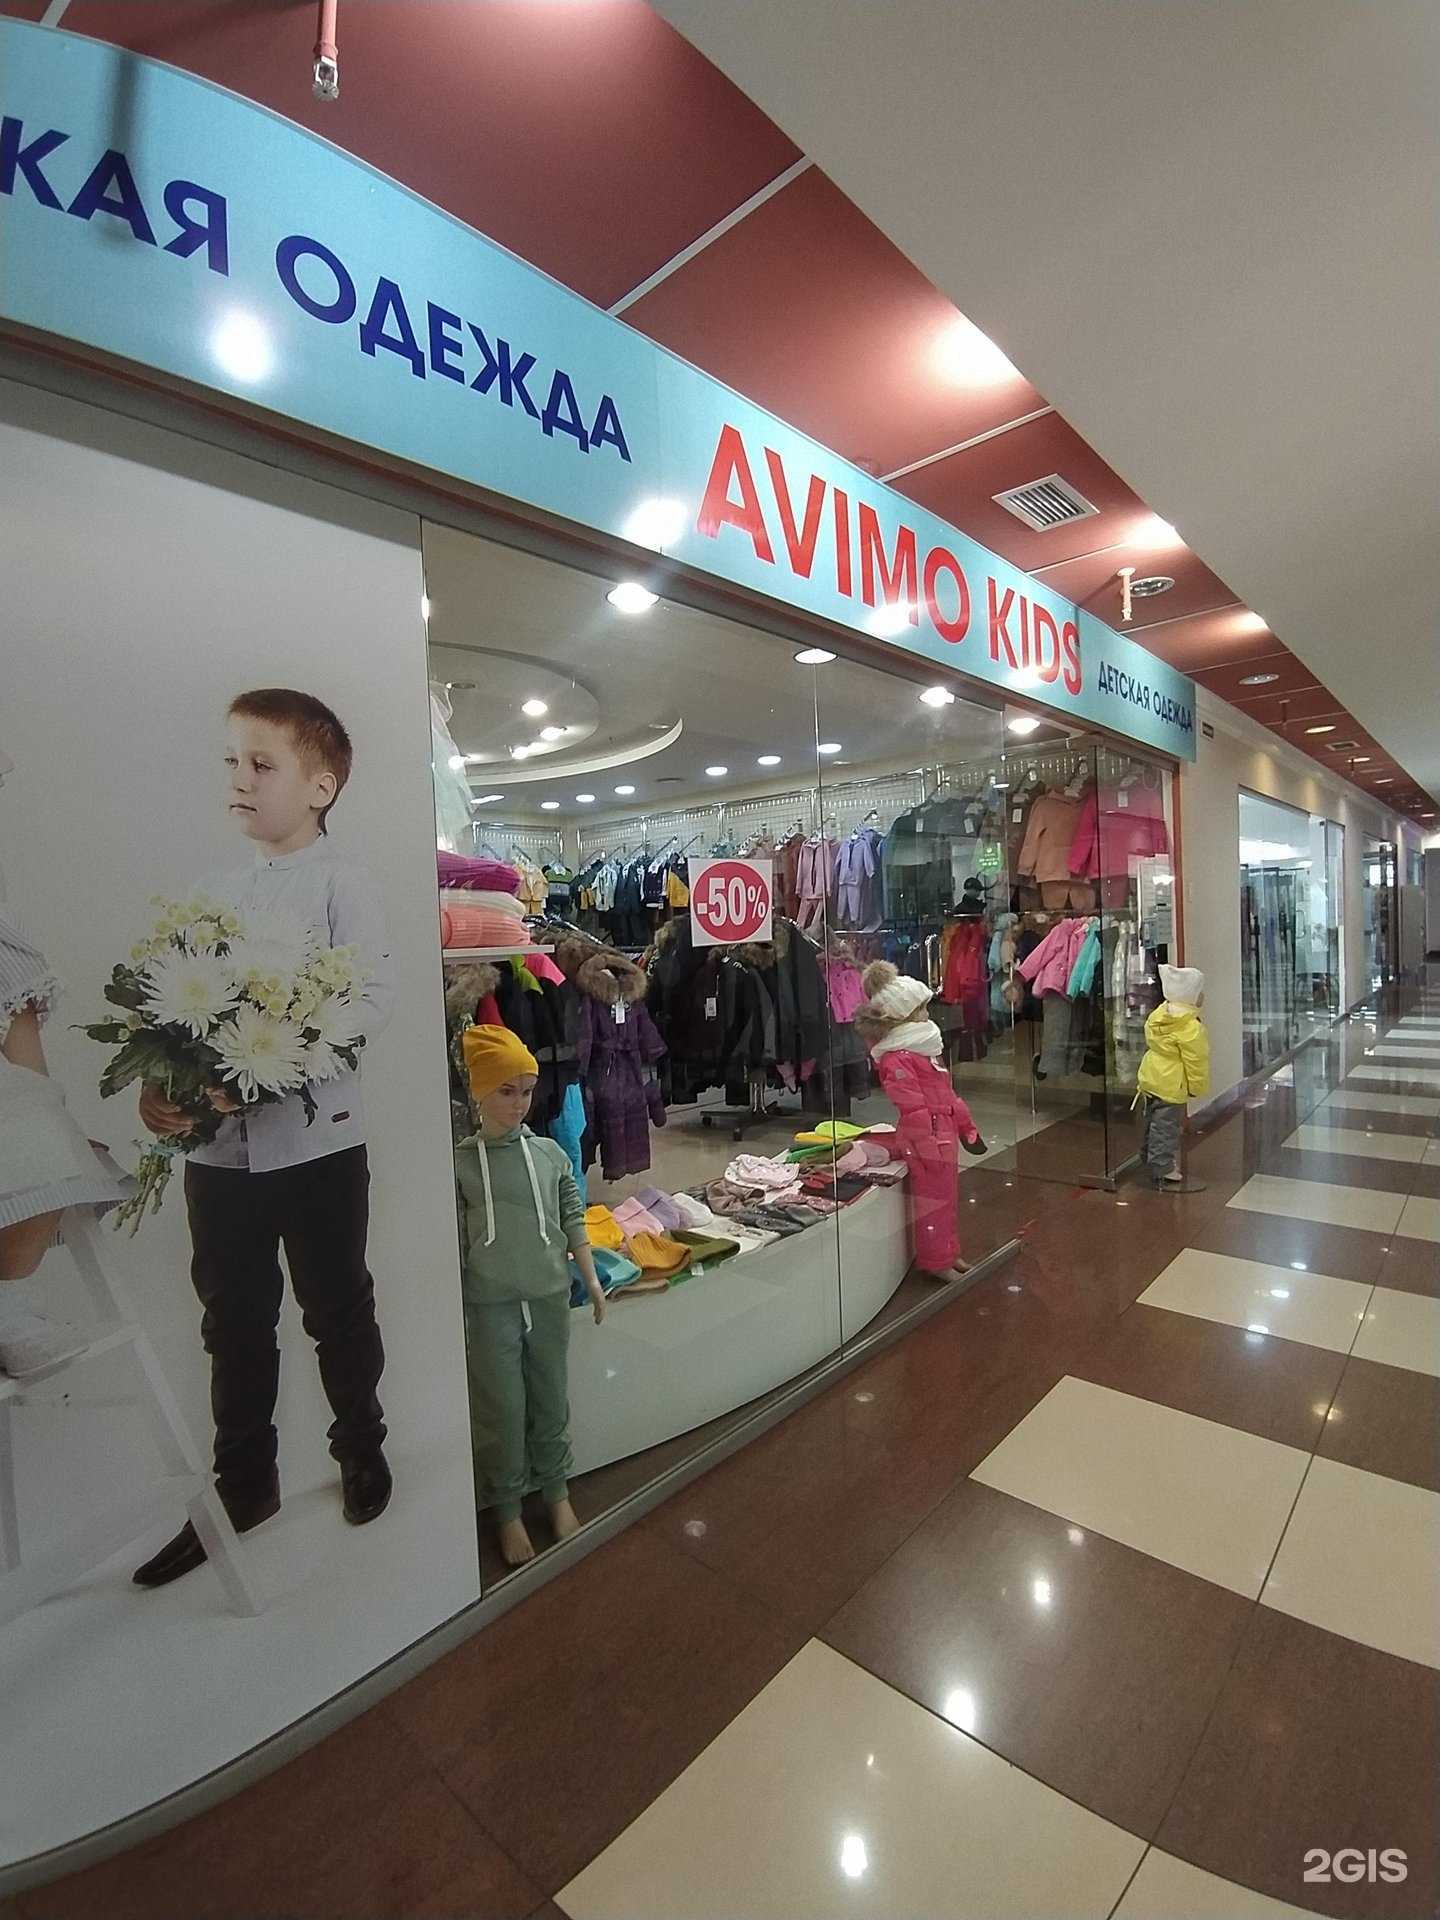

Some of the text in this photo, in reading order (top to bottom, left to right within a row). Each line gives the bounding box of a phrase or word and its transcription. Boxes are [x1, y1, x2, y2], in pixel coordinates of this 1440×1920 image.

[0, 115, 633, 464] КАЯ ОДЕЖДА
[696, 423, 1083, 696] AVIMO KIDS
[1098, 660, 1193, 733] ДЕТСКАЯ ОДЕЖДА
[697, 876, 766, 926] -50%
